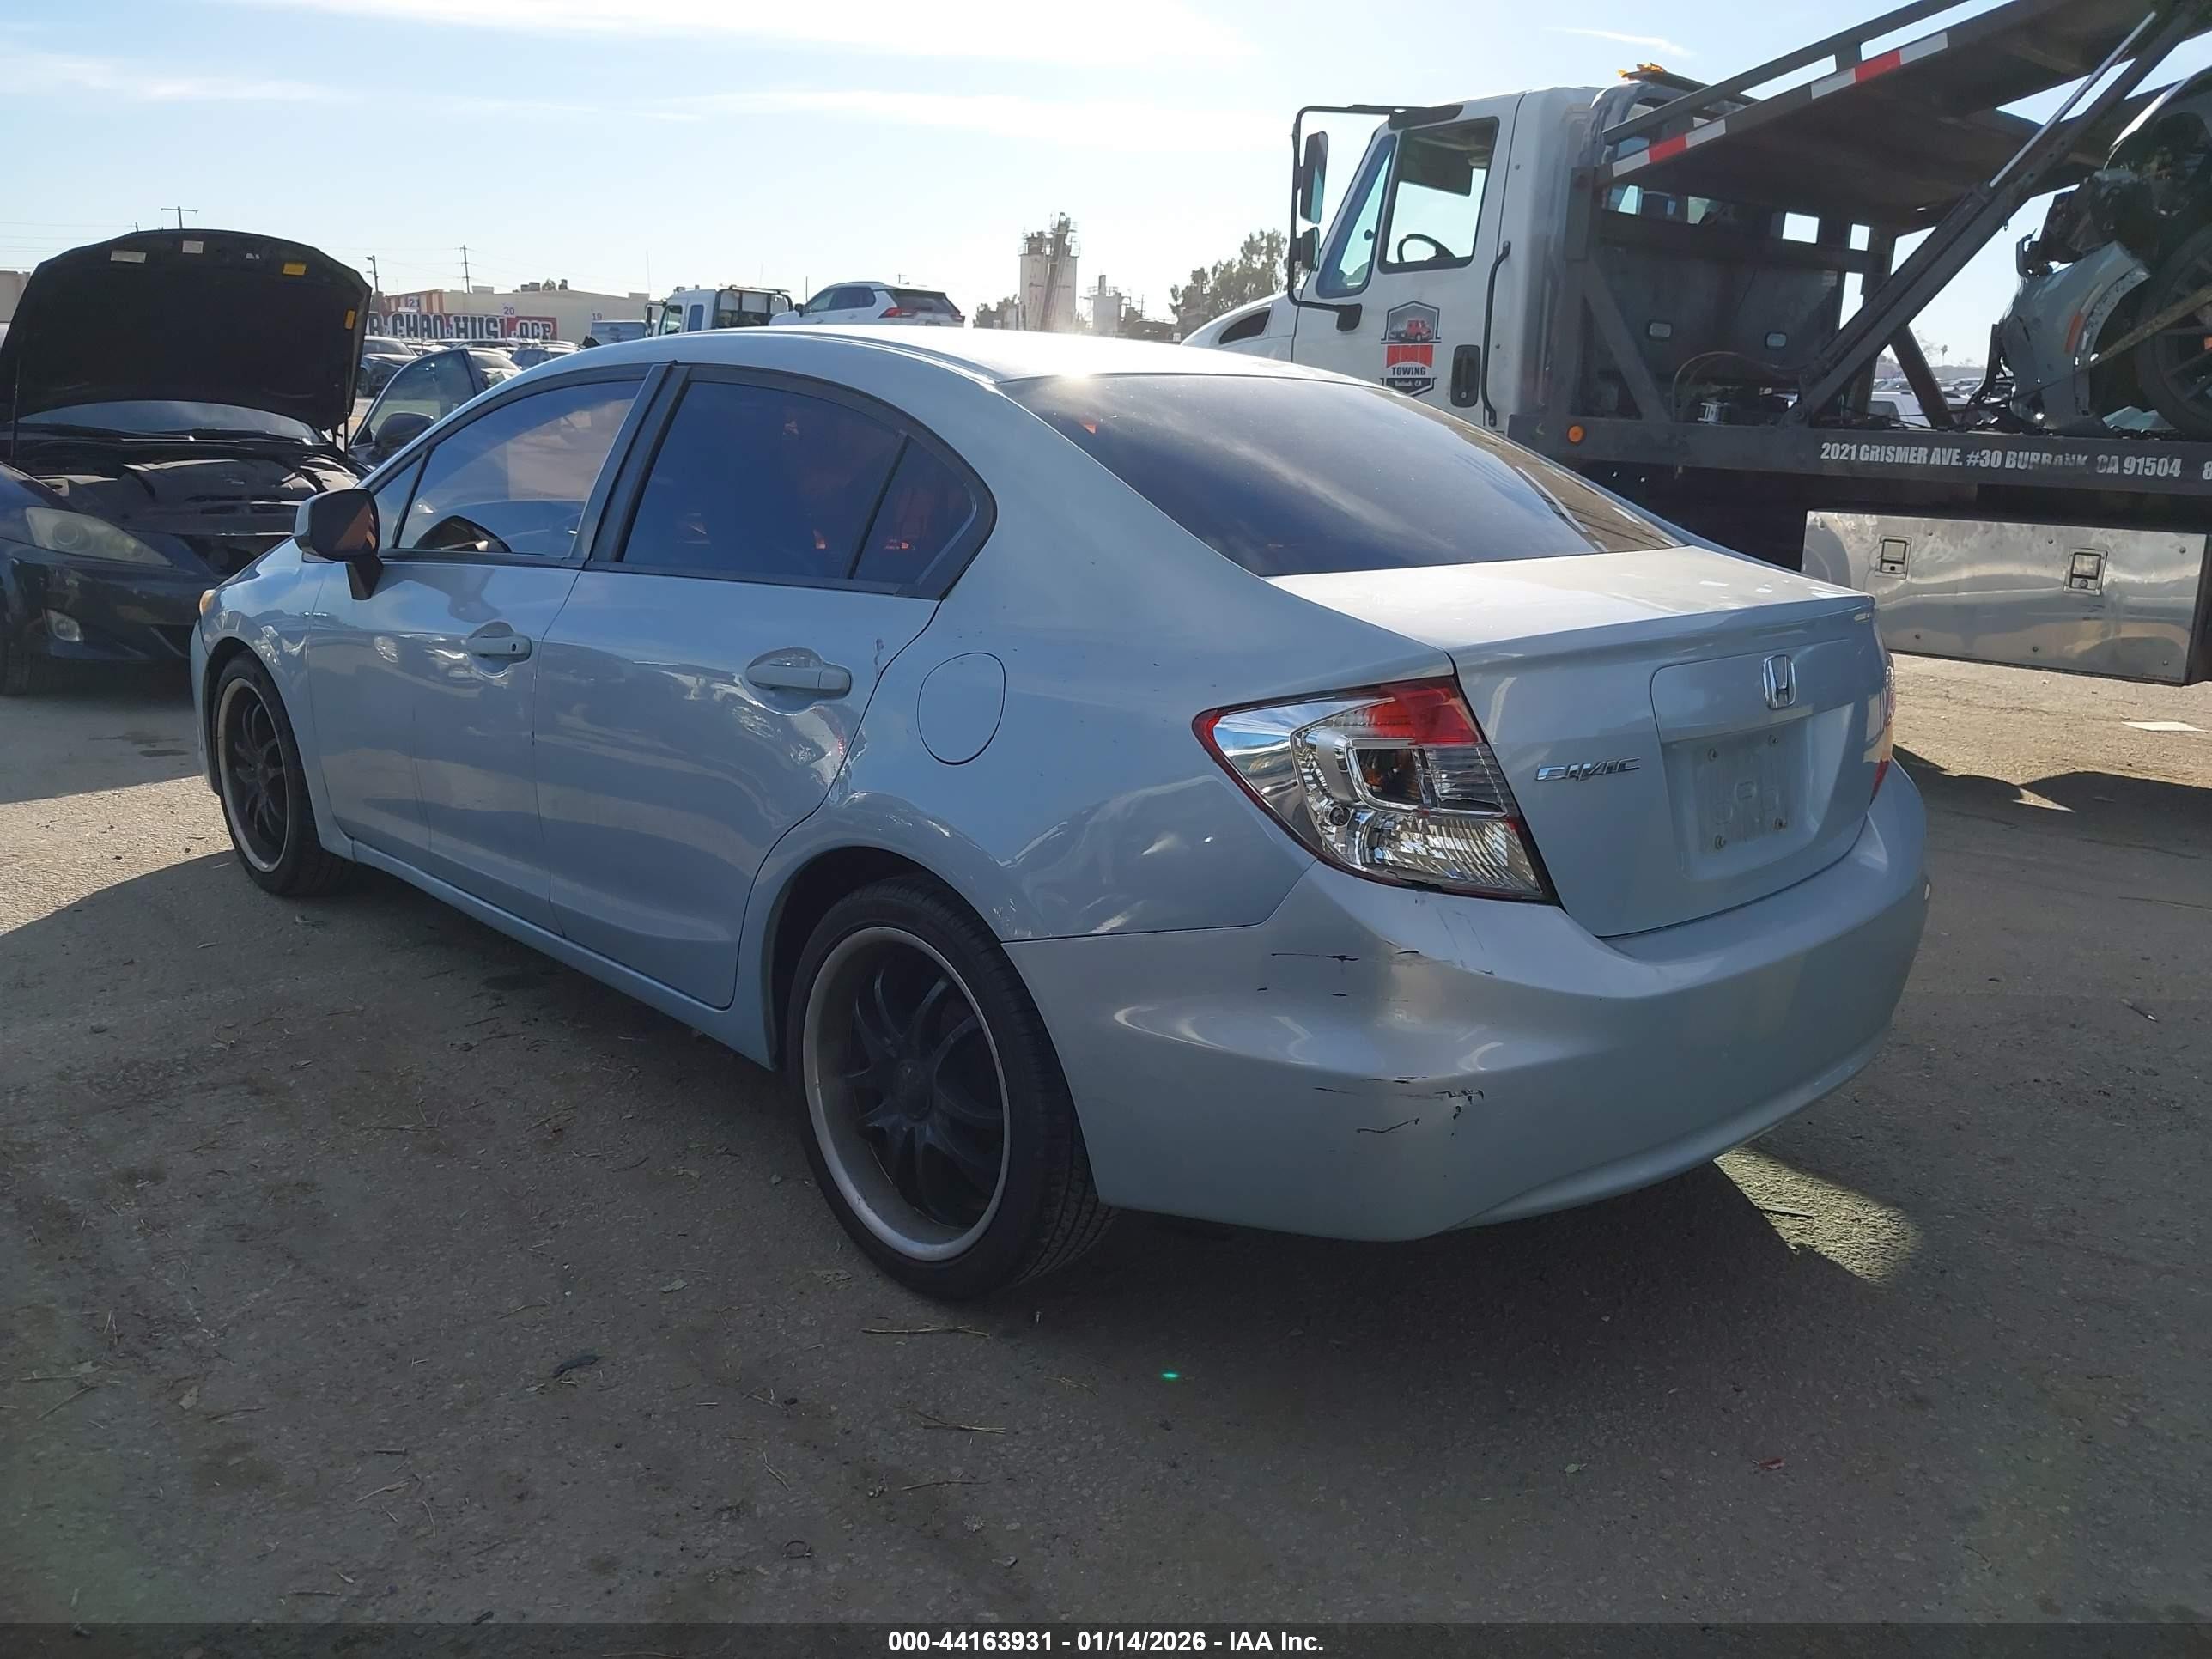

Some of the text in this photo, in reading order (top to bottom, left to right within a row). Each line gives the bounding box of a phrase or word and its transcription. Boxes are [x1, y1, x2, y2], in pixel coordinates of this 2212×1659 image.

[503, 307, 515, 316] 20
[1391, 367, 1426, 376] TOWING
[1820, 442, 1856, 461] 2021
[1859, 444, 1929, 465] GRISMER
[1929, 447, 1963, 466] AVE.
[1966, 449, 2003, 468] #30
[2096, 454, 2119, 474] CA
[2123, 456, 2183, 477] 91504
[1534, 757, 1642, 781] CIVIC
